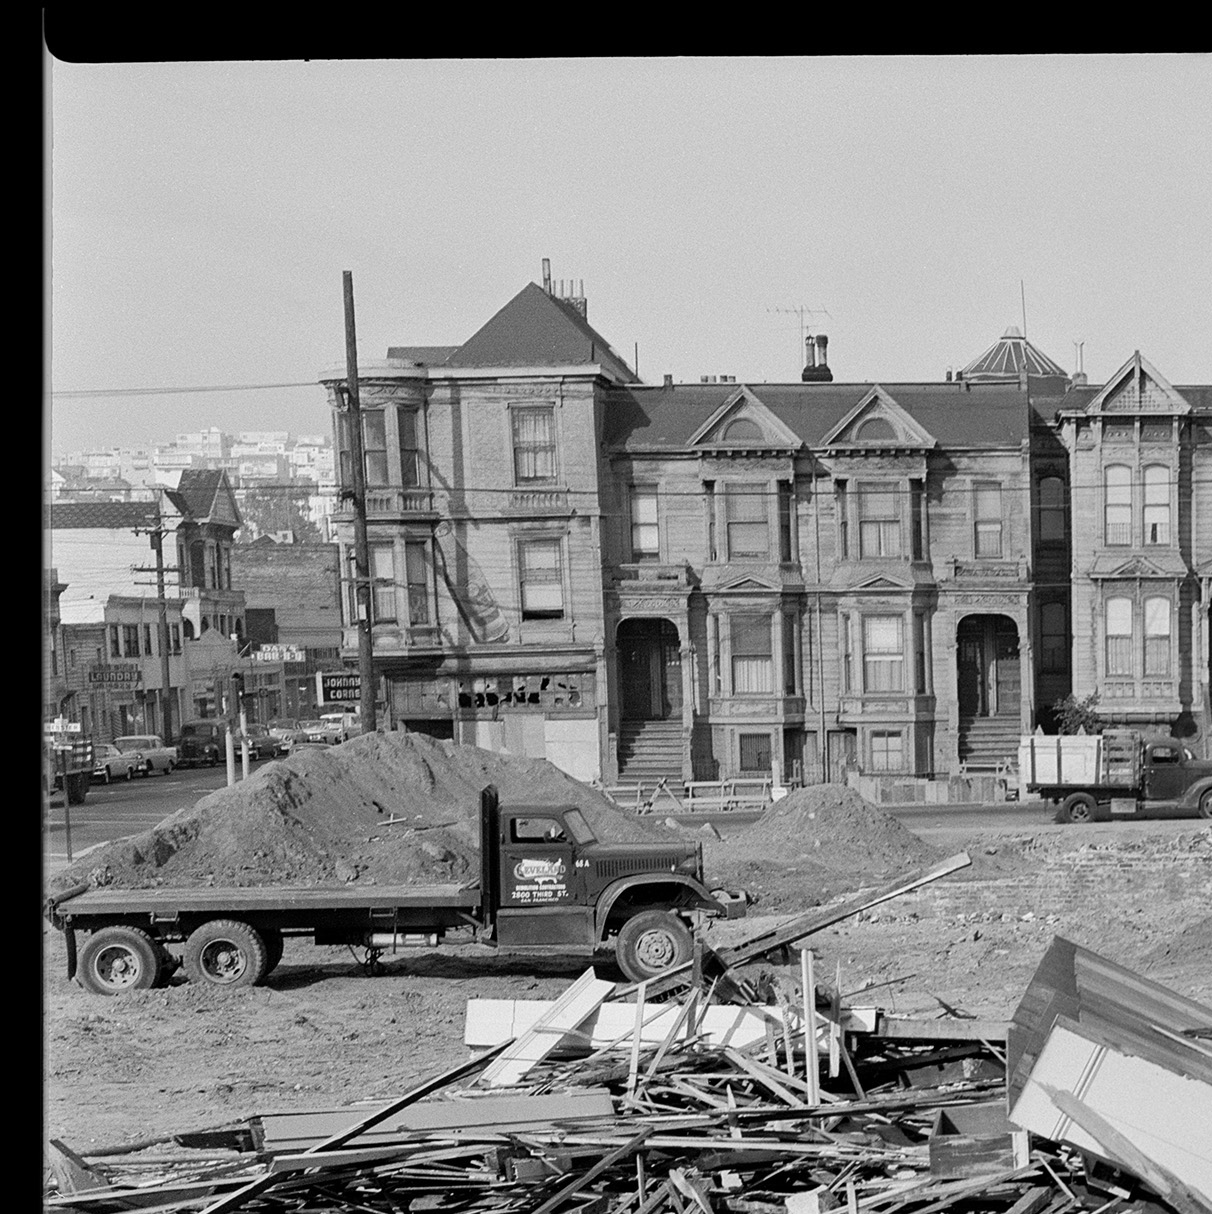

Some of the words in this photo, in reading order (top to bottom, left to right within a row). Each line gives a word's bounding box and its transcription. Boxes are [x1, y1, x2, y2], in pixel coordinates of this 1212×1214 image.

[91, 673, 138, 681] LAUNDRY
[330, 689, 361, 699] CORNE
[532, 890, 553, 898] THIRD
